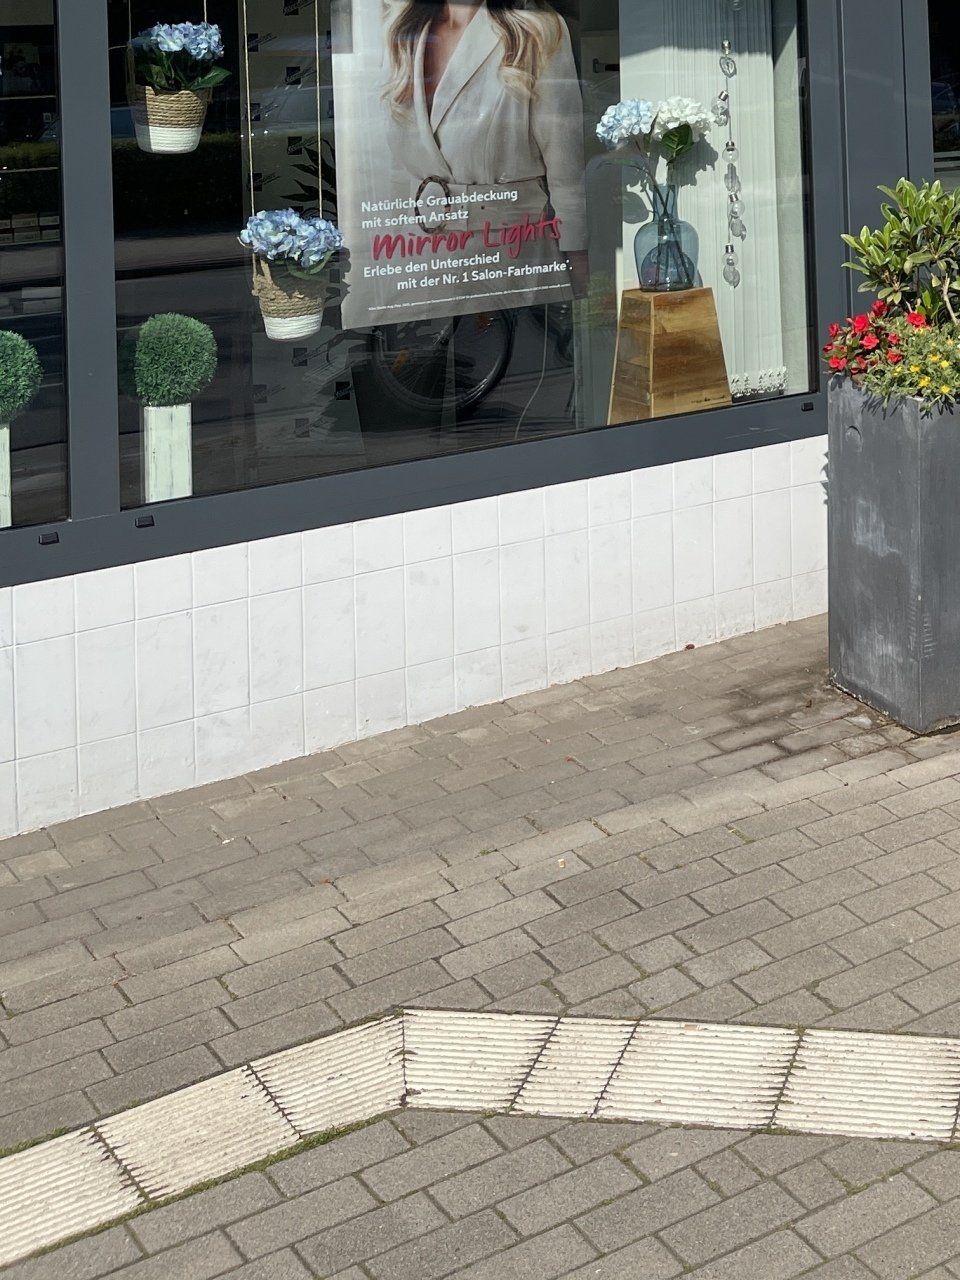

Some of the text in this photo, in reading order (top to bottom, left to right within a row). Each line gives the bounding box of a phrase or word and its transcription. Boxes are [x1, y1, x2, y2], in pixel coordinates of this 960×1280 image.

[361, 189, 518, 212] Natürliche Grauabdeckung
[361, 209, 469, 229] mit softem Ansatz
[482, 212, 563, 259] Lights
[364, 252, 500, 278] Erlebe den Unterschied
[397, 277, 417, 290] mit
[419, 273, 440, 287] der
[442, 273, 460, 285] Nr.
[462, 271, 469, 283] 1
